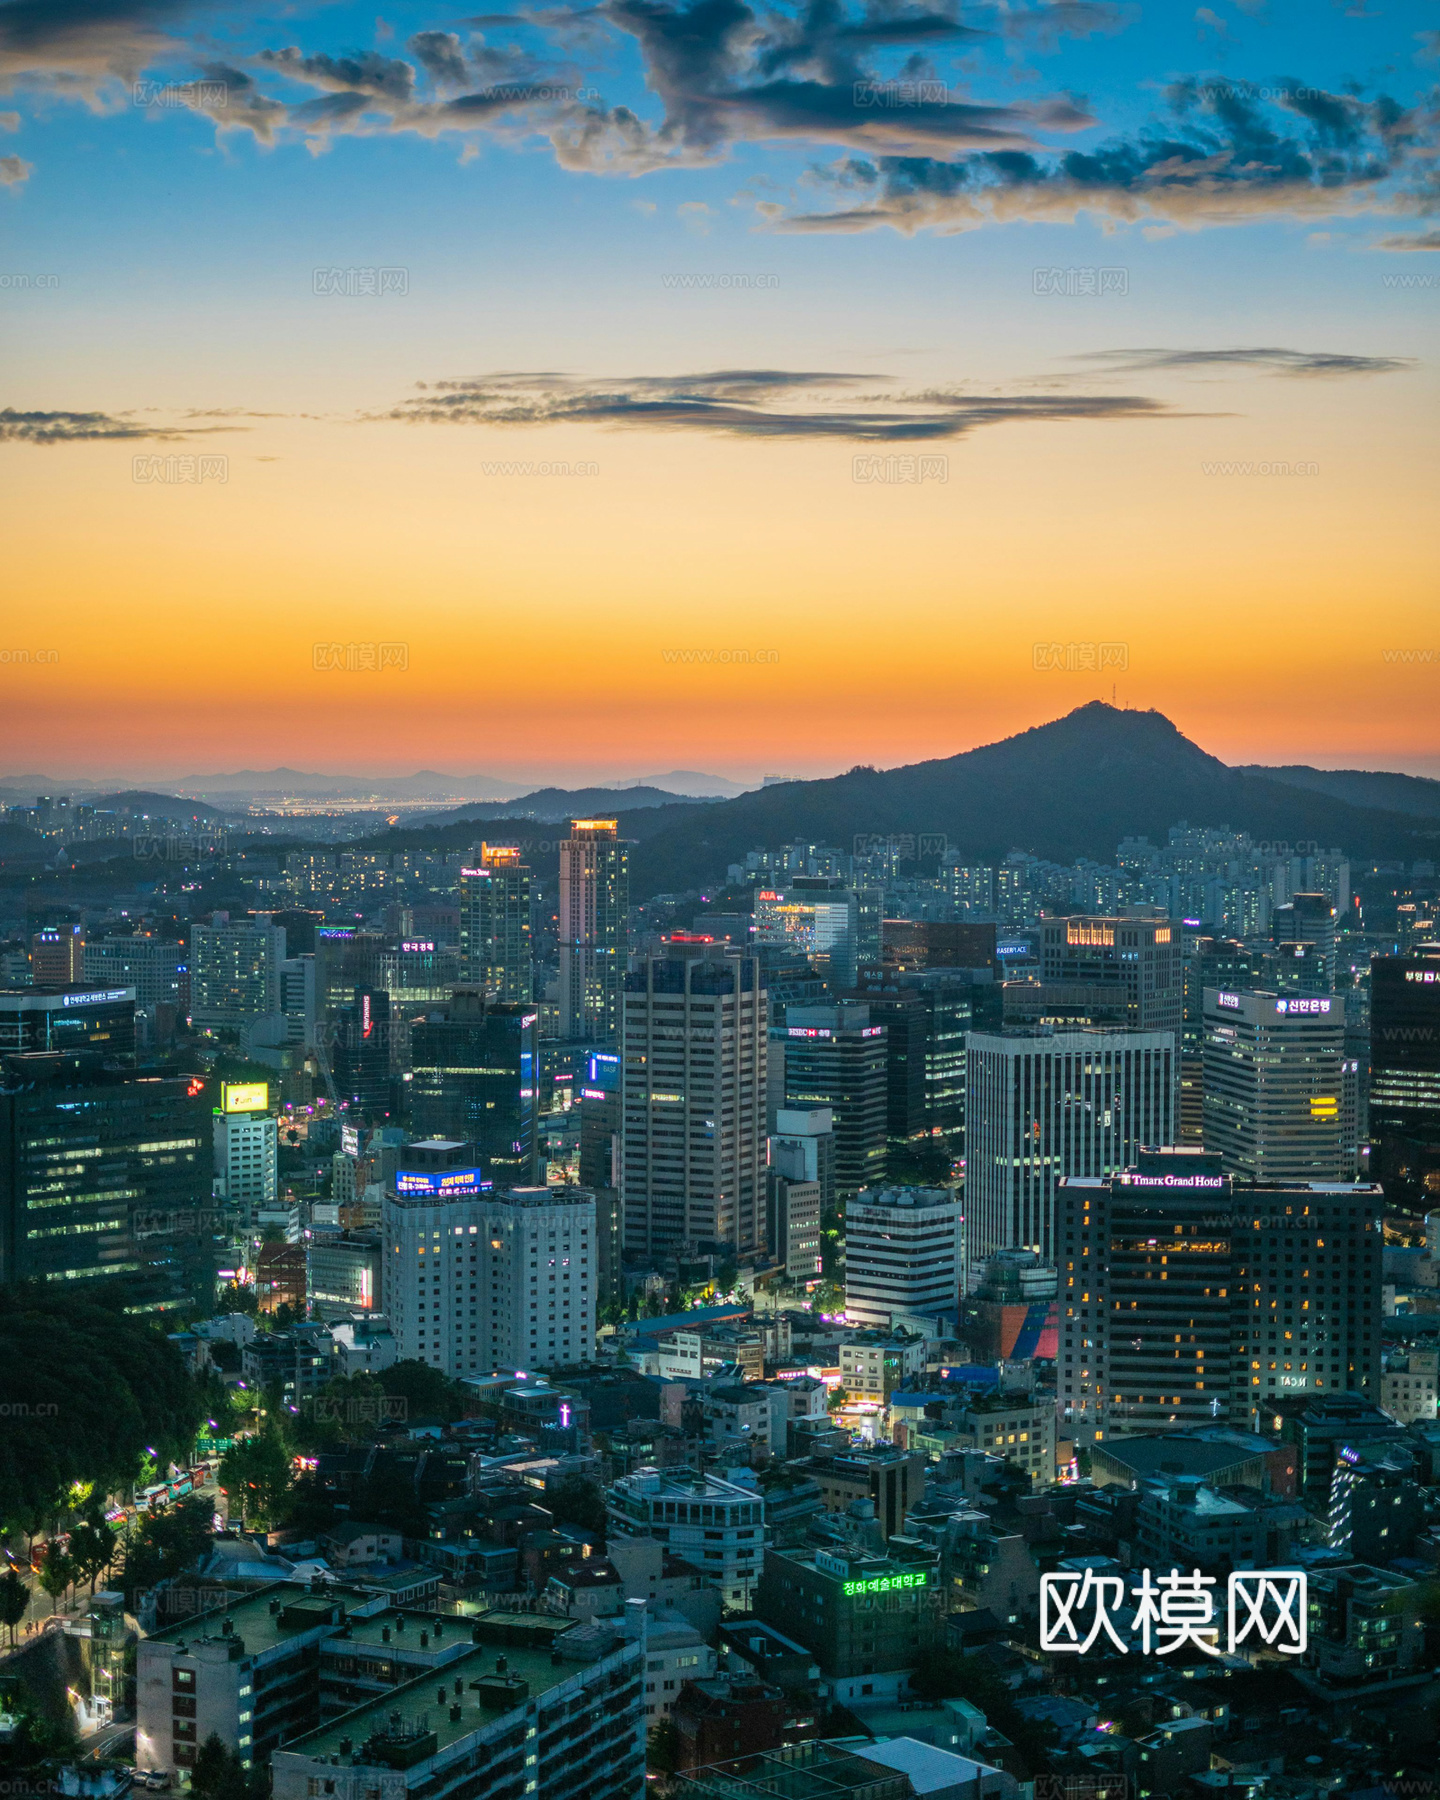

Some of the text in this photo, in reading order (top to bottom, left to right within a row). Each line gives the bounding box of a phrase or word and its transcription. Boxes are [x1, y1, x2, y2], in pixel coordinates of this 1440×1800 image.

[759, 891, 777, 901] AIA
[1288, 1000, 1331, 1013] 신한은행
[187, 1087, 198, 1097] SK
[1132, 1174, 1165, 1187] Tmark
[1164, 1174, 1194, 1188] Grand
[1194, 1175, 1223, 1189] Hotel
[842, 1573, 926, 1596] 정화예술대학교
